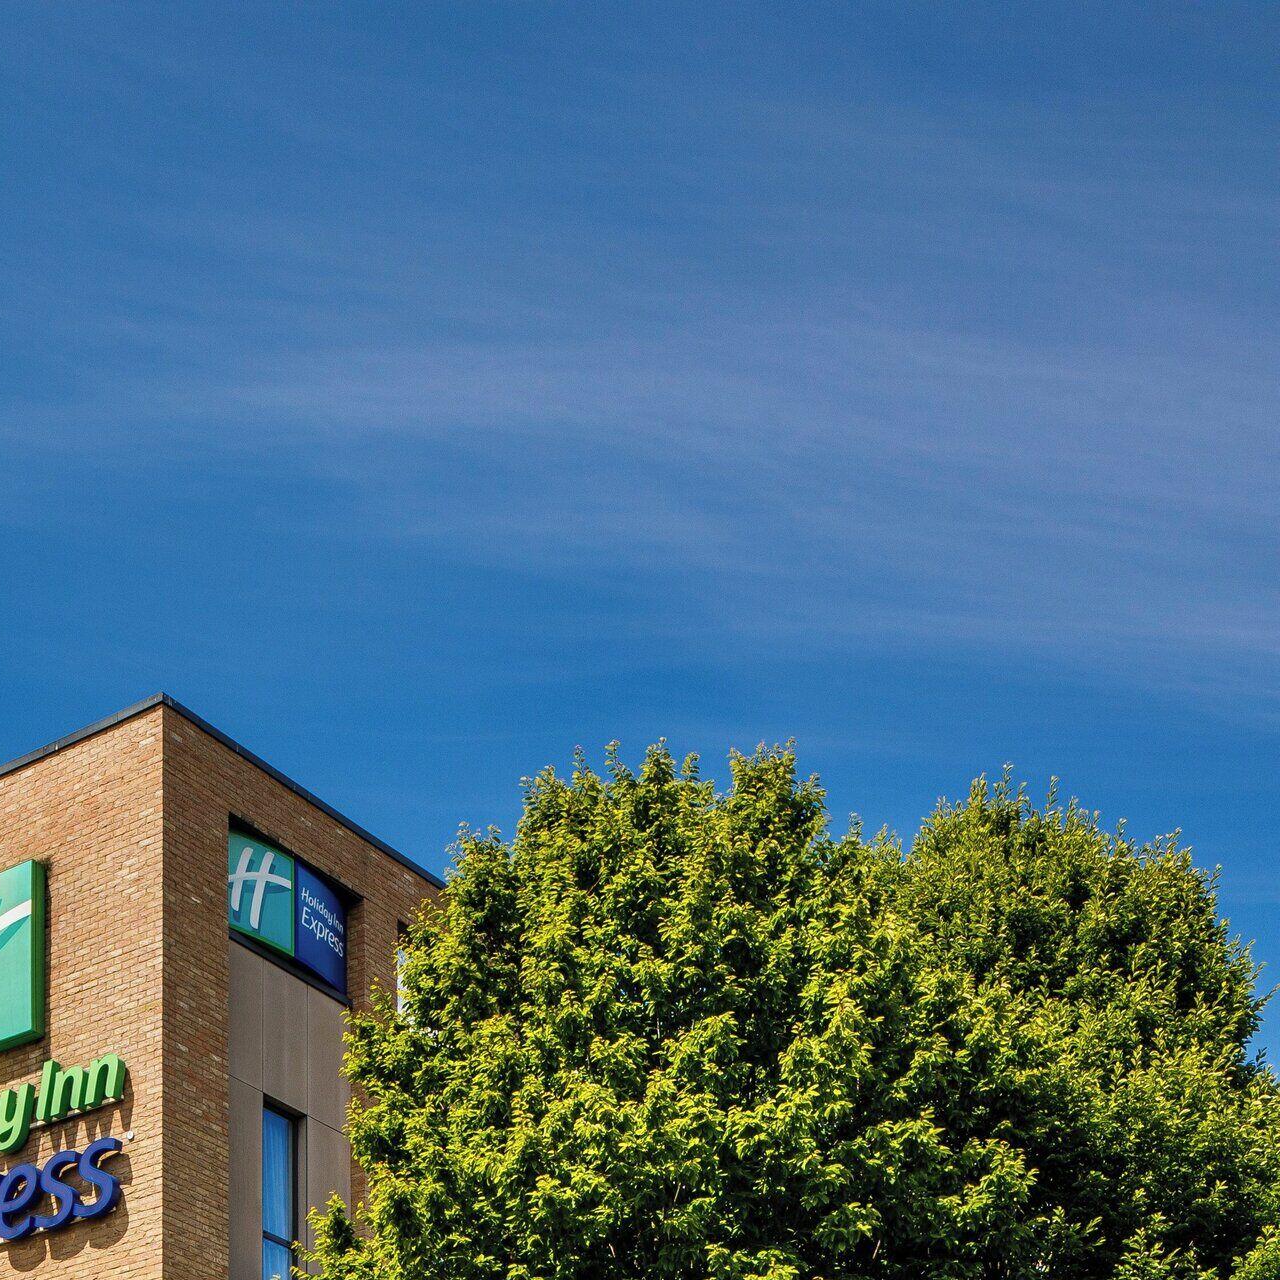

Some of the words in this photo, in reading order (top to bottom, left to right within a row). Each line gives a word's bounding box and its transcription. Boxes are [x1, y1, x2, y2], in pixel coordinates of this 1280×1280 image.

[301, 887, 333, 925] Holiday
[334, 912, 344, 934] Inn
[301, 906, 344, 958] Express
[36, 1053, 126, 1122] Inn
